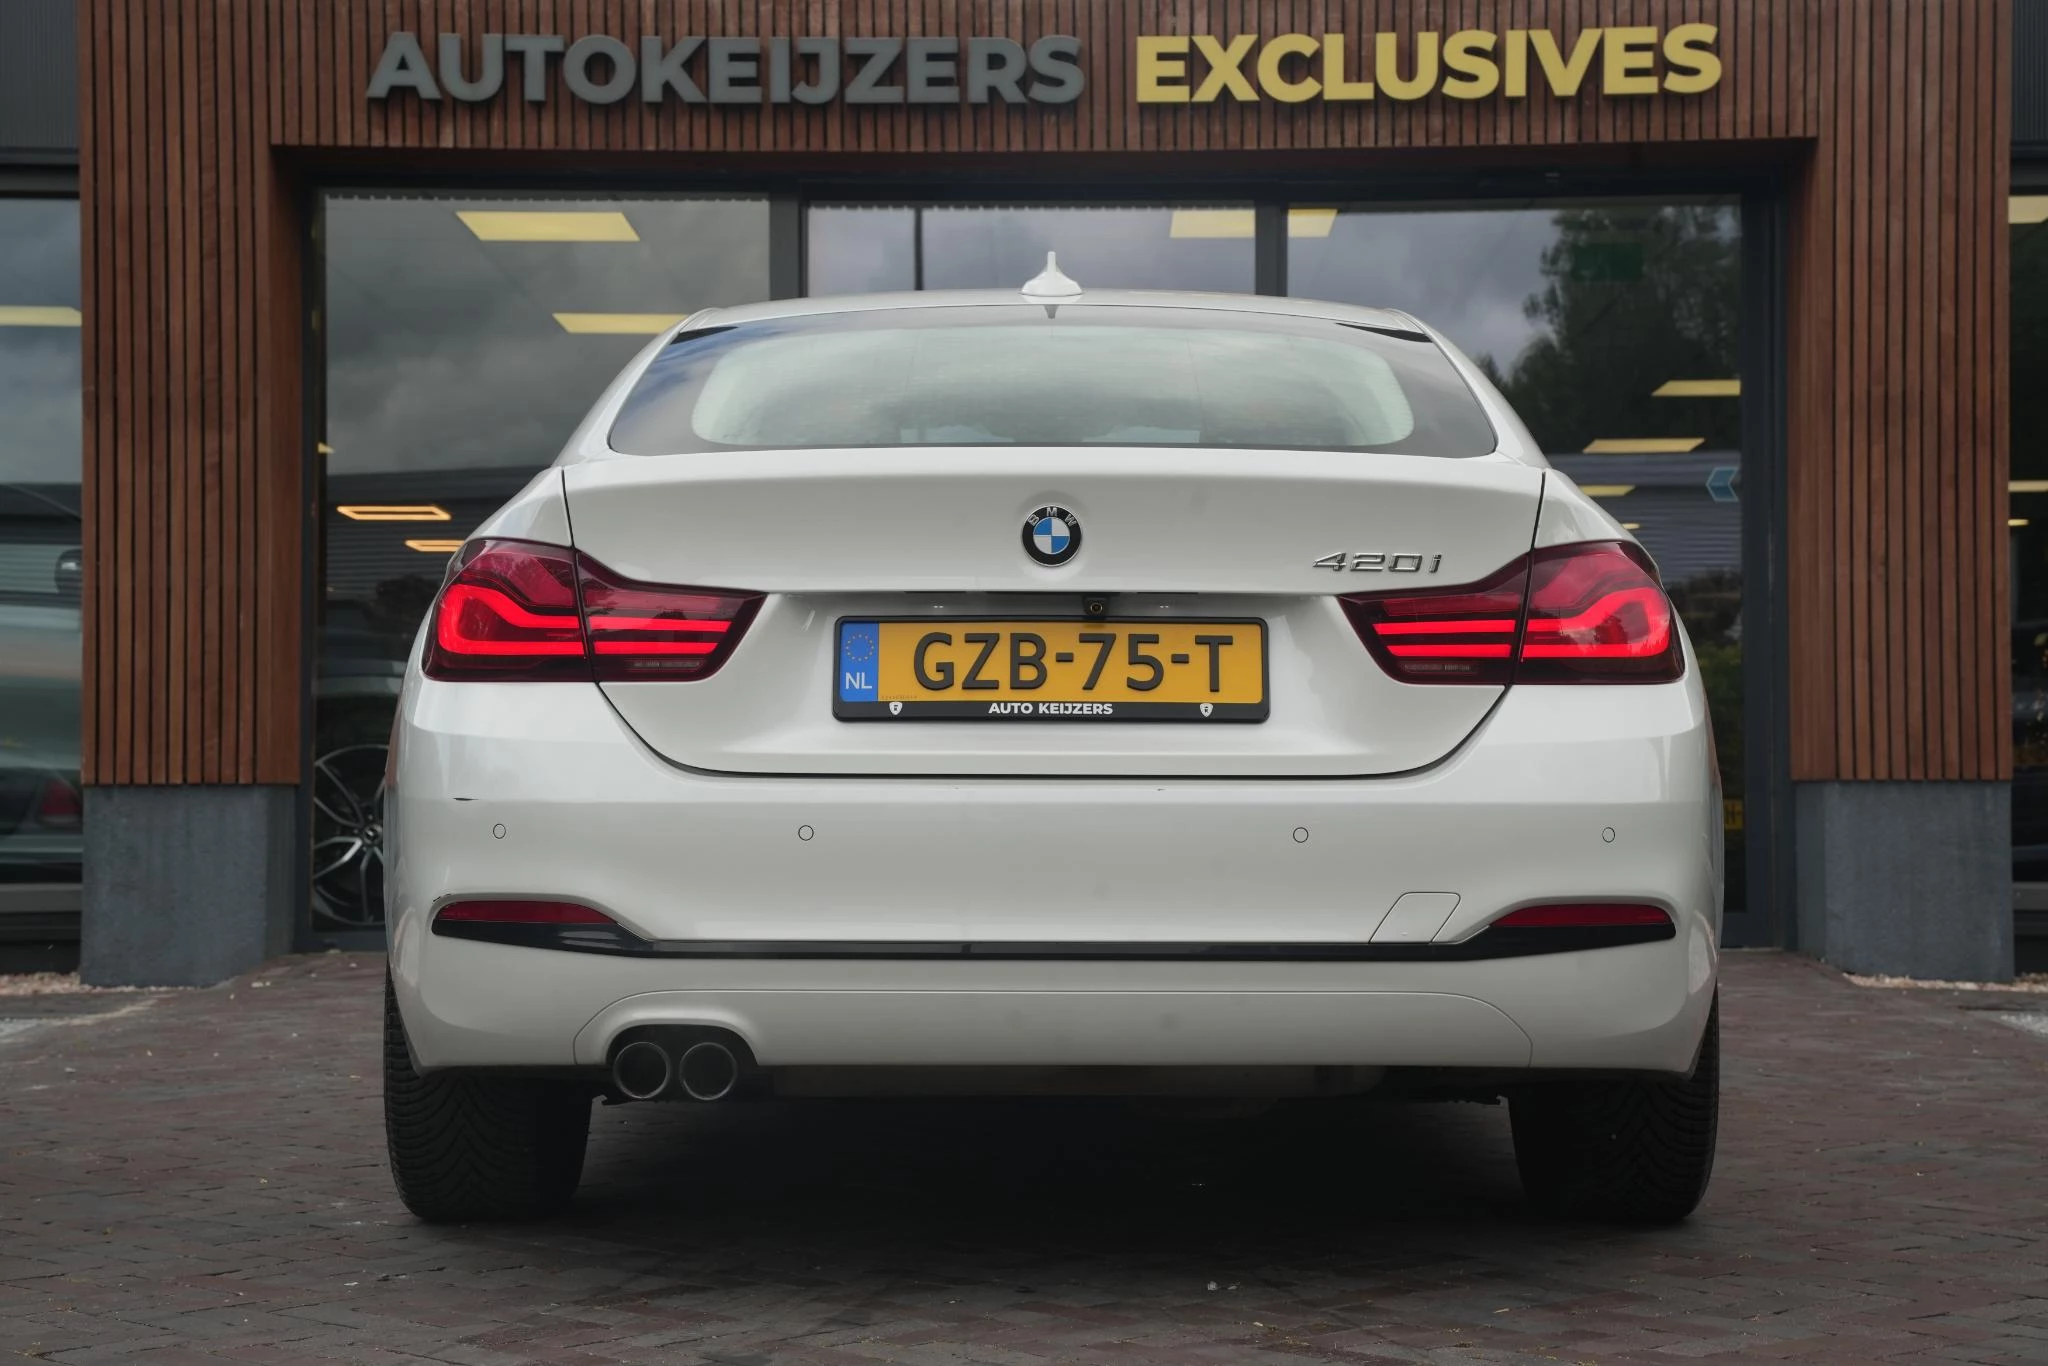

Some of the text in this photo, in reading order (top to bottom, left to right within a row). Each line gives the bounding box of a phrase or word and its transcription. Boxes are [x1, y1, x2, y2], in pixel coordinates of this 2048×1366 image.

[1136, 22, 1722, 103] EXCLUSIVES
[1028, 507, 1077, 527] BMW
[1312, 552, 1442, 573] 420i
[913, 632, 1234, 693] GZB-75-T
[845, 671, 873, 689] NL
[988, 702, 1114, 715] AUTO KEIJZERS
